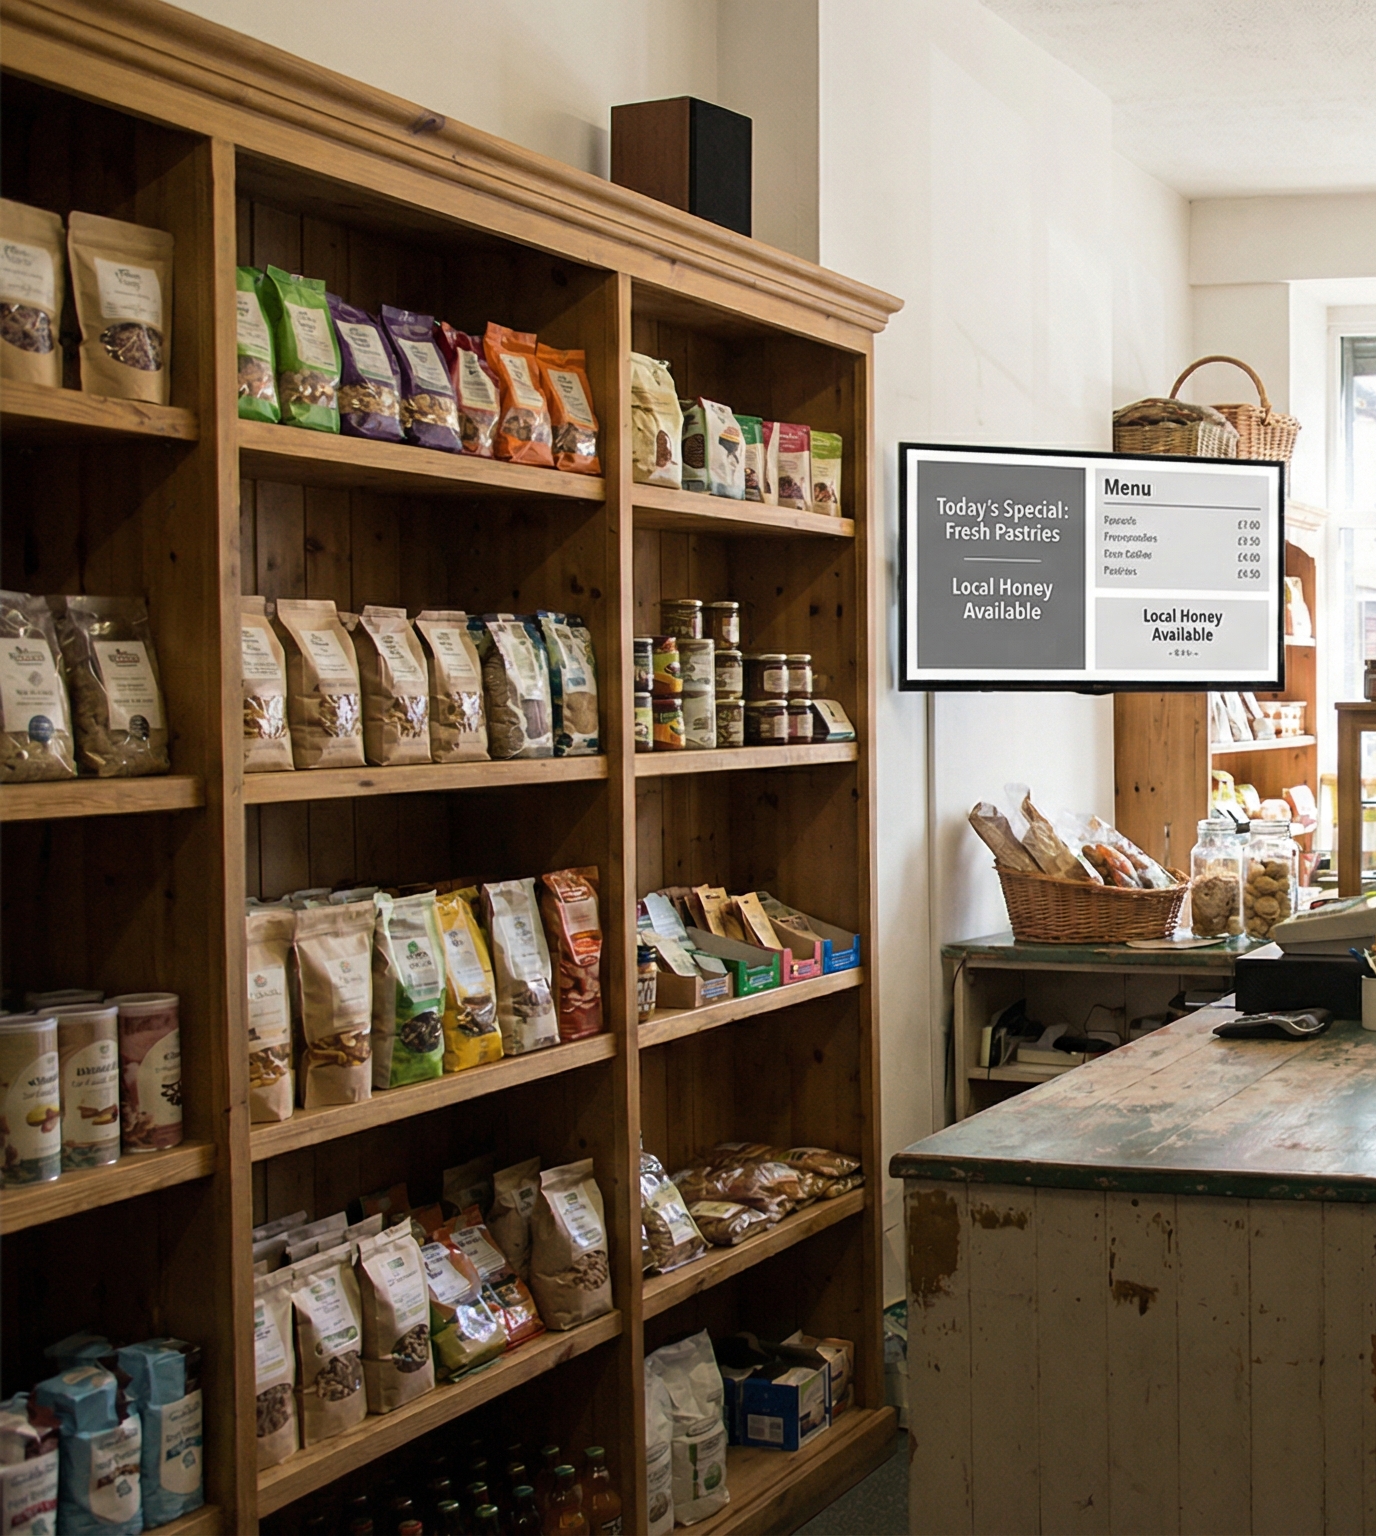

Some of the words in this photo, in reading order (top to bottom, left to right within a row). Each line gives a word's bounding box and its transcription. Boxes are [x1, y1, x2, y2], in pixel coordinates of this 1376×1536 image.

[1104, 478, 1152, 497] Menu
[936, 497, 999, 523] Today's
[1003, 500, 1069, 521] Special:
[946, 522, 990, 541] Fresh
[995, 523, 1060, 542] Pastries
[952, 577, 994, 596] Local
[999, 578, 1053, 601] Honey
[963, 601, 1042, 620] Available
[1143, 608, 1176, 623] Local
[1180, 608, 1223, 628] Honey
[1152, 626, 1214, 642] Available
